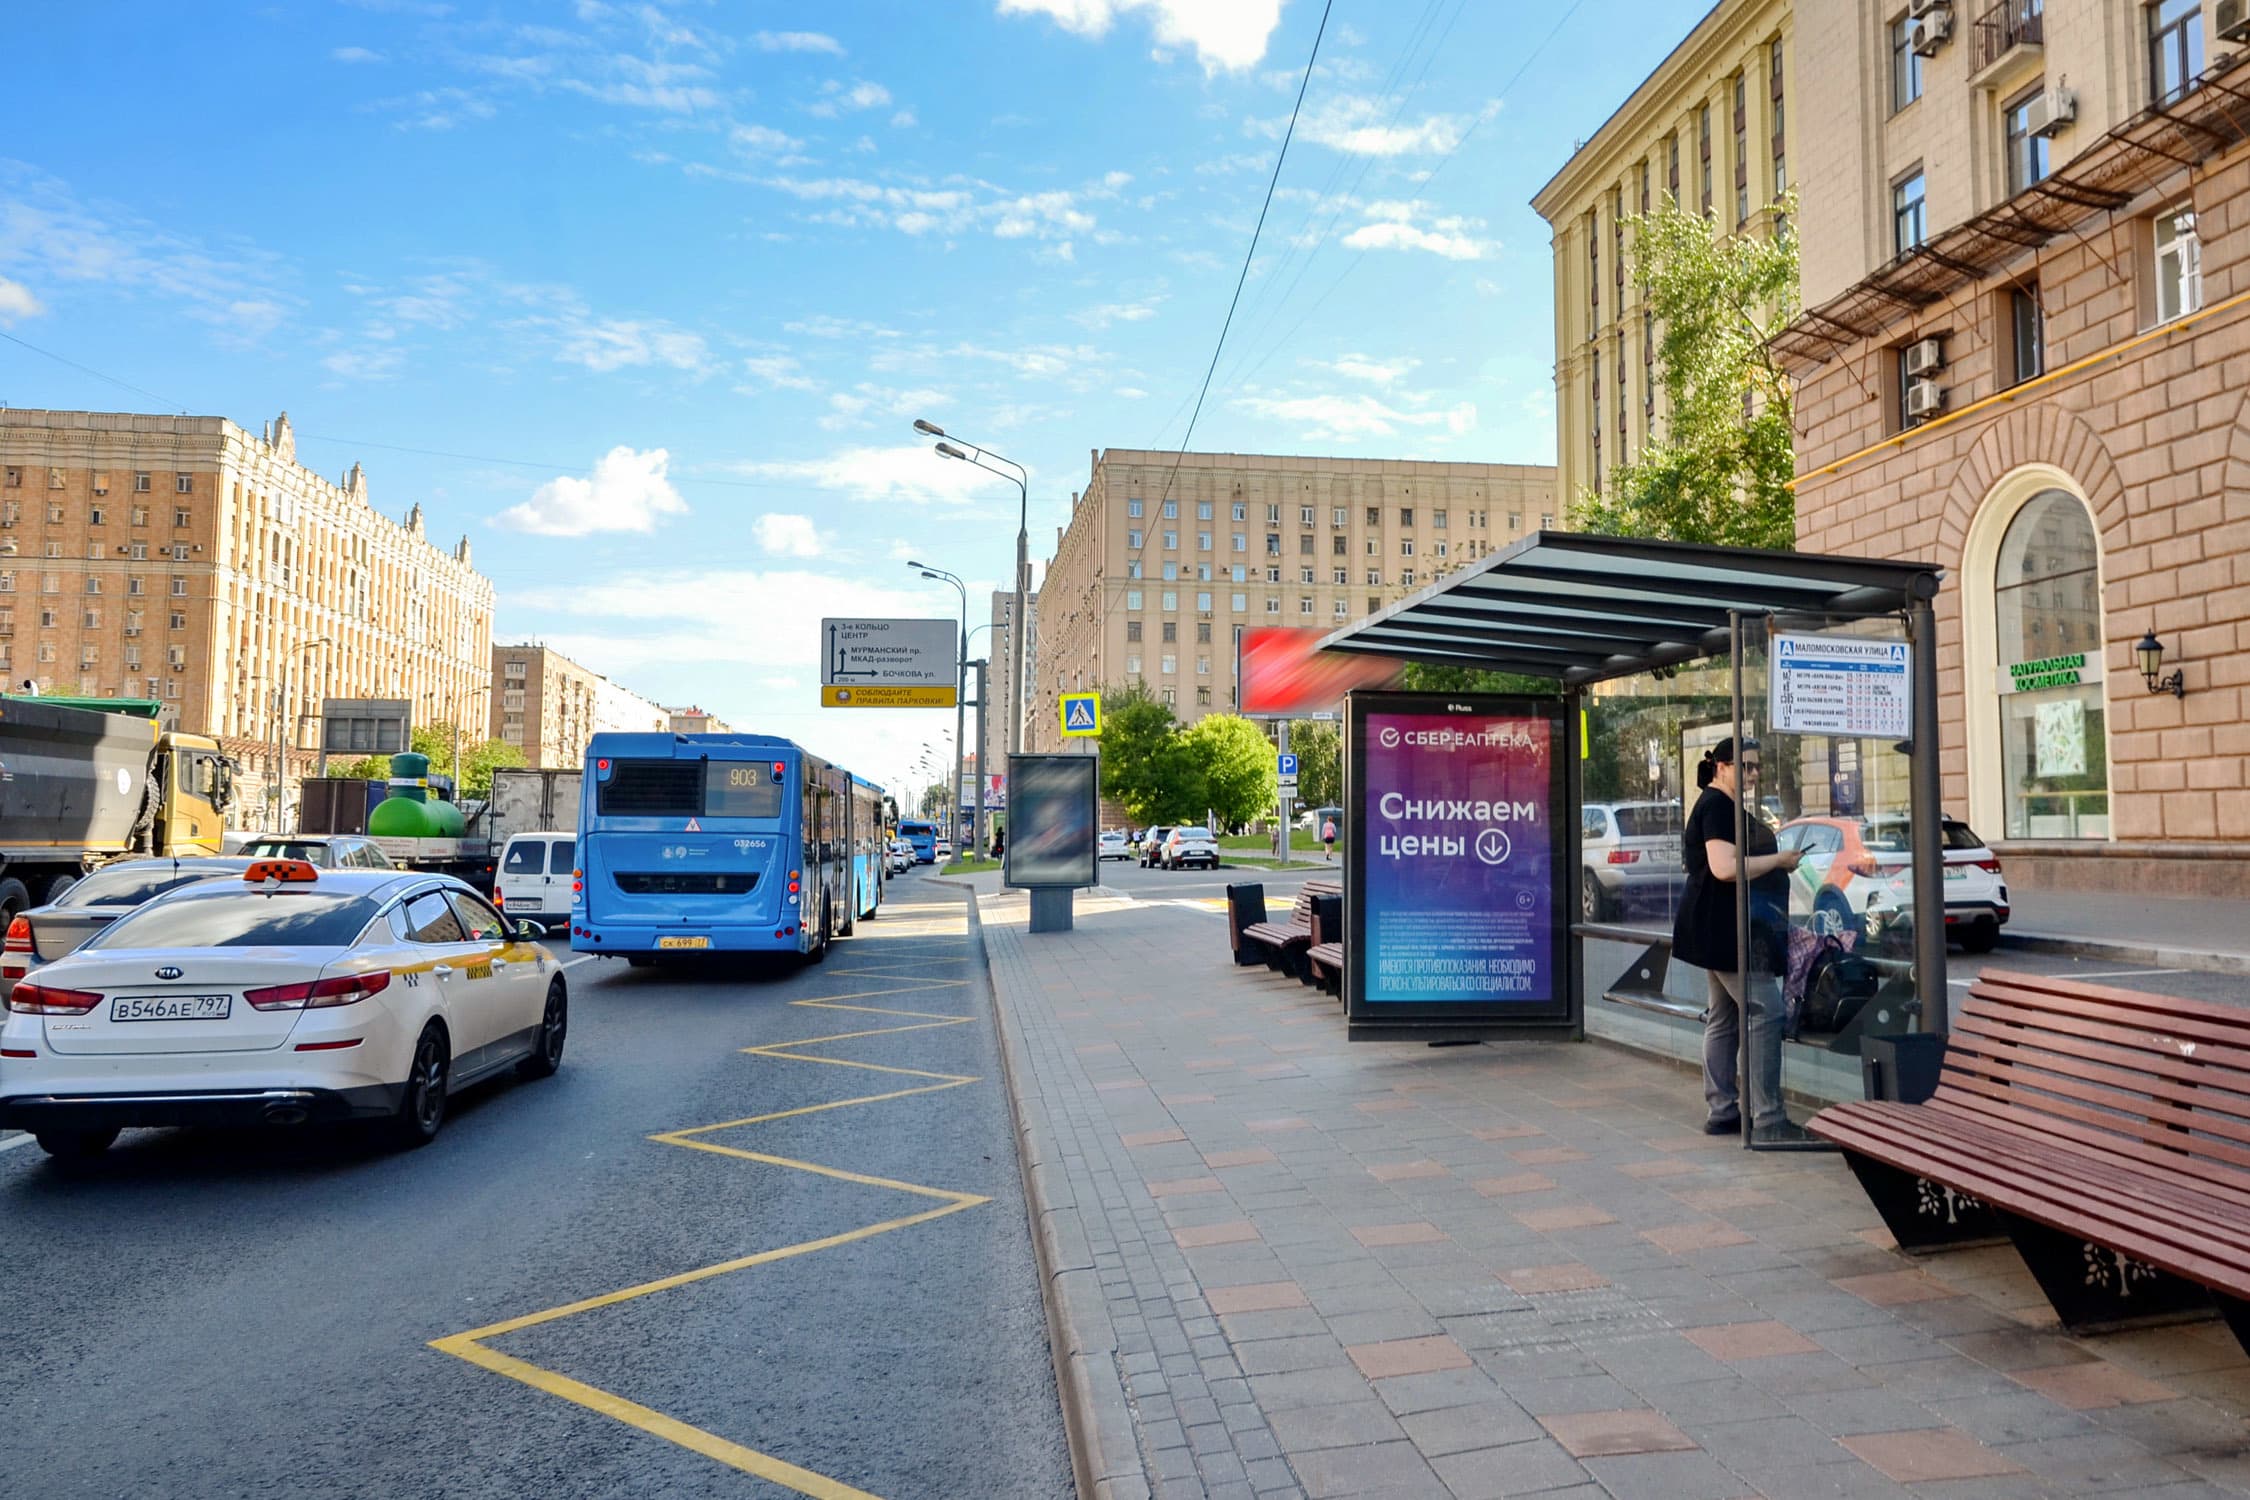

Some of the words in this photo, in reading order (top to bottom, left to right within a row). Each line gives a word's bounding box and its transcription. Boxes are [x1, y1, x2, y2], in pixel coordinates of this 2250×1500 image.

[855, 623, 890, 631] КОЛЬЦО
[841, 632, 869, 640] ЦЕНТР
[850, 645, 908, 654] МУРМАНСКИЙ
[909, 648, 922, 656] пр.
[1795, 643, 1863, 654] МАЛОМОСКОВСКАЯ
[1864, 646, 1889, 656] УЛИЦА
[850, 655, 913, 663] МКАД-разворот
[2010, 654, 2085, 677] НАТУРАЛЬНАЯ
[882, 670, 922, 678] БОЧКОВА
[924, 671, 936, 679] ул.
[2015, 670, 2080, 691] КОСМЕТИКА
[855, 689, 912, 697] СОБЛЮДАЙТЕ
[855, 697, 895, 705] ПРАВИЛА
[896, 697, 944, 705] ПАРКОВКИ!
[1282, 756, 1294, 773] P
[730, 768, 757, 786] 903
[1379, 792, 1535, 821] Снижаем
[1380, 834, 1465, 860] цены
[159, 967, 180, 977] KIA
[118, 1000, 192, 1018] В546АЕ
[197, 997, 225, 1011] 797
